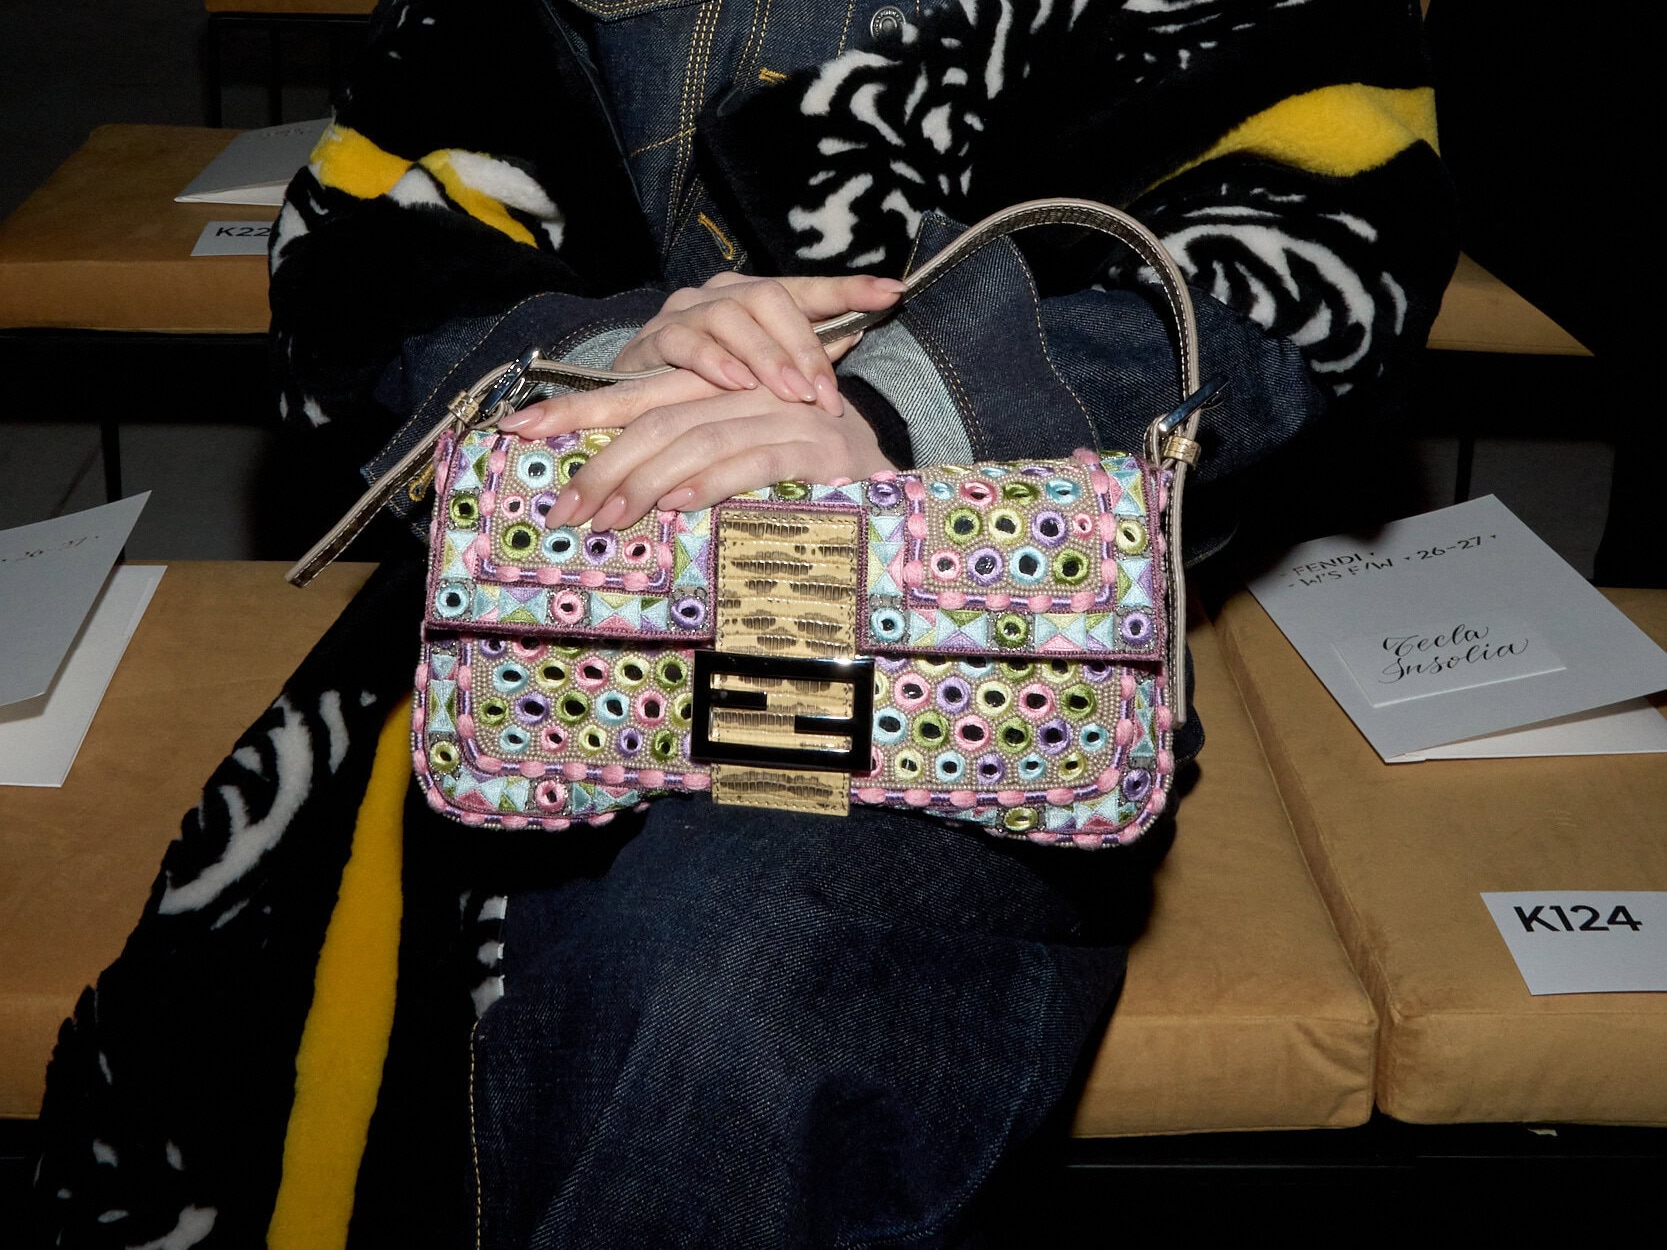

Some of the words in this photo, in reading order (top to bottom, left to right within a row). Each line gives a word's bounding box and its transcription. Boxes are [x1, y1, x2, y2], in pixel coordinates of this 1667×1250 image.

[1416, 536, 1482, 561] 26-27
[1292, 553, 1364, 576] FENDI
[1382, 623, 1489, 657] Tecla
[1513, 905, 1643, 932] K124
